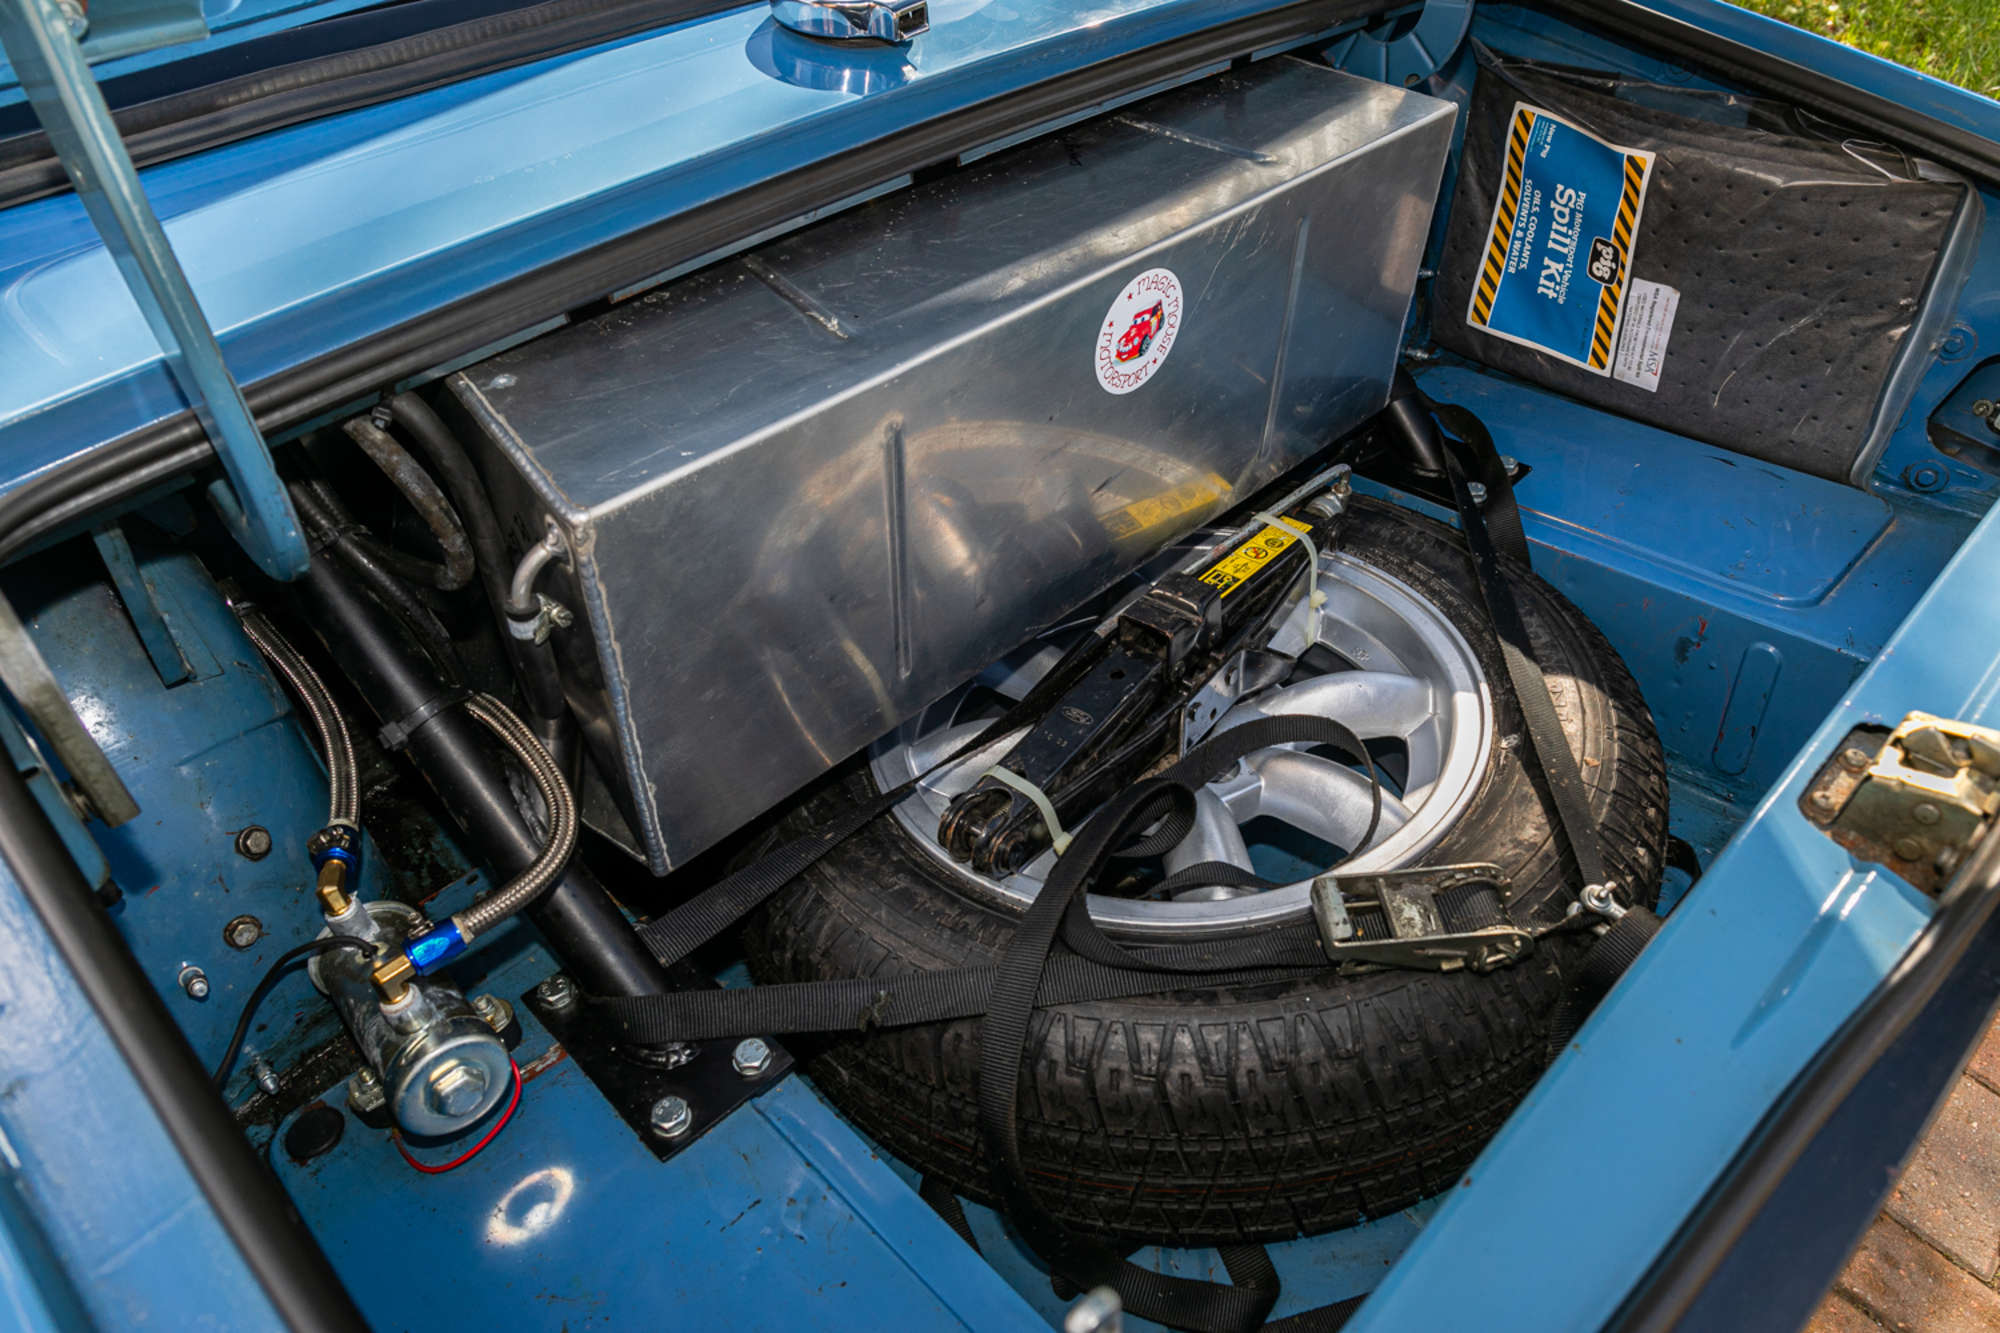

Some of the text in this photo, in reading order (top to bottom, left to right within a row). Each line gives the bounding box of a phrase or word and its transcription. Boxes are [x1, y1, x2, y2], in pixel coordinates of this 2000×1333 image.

[1517, 178, 1533, 229] SOLVENTS
[1507, 240, 1522, 274] WATER
[1536, 183, 1577, 299] Spill Kit
[1557, 191, 1587, 304] PIG Motorsport Vehicle
[1591, 241, 1617, 280] pig
[1137, 273, 1180, 356] MAGIC MOUSE
[1099, 331, 1151, 389] MOTORSPORT
[1645, 350, 1659, 374] MSA
